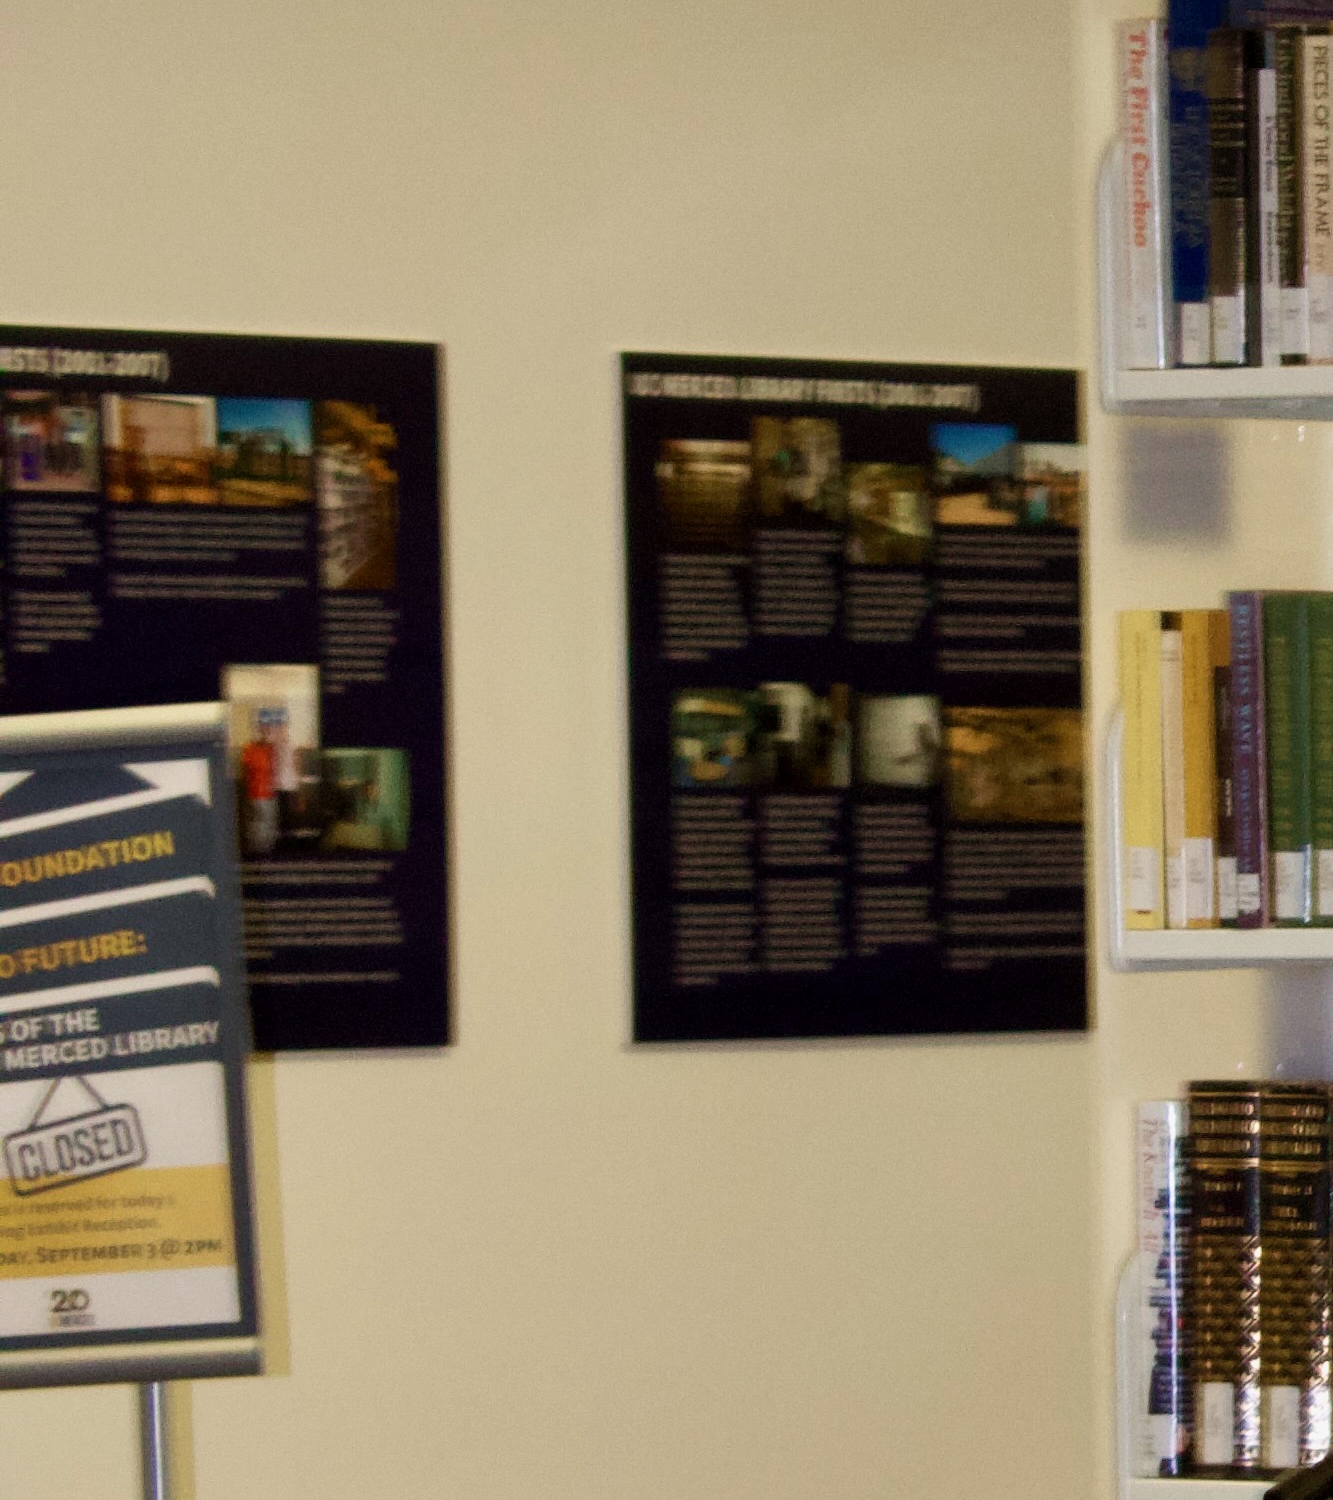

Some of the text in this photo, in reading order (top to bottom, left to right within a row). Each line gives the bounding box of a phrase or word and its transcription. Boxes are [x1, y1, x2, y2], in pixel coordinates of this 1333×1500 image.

[1129, 32, 1152, 248] The First Cuckoo
[1311, 44, 1333, 238] PIECES OF THE FRAME
[20, 930, 148, 975] FUTURE:
[3, 1020, 221, 1072] MERCED LIBRARY
[10, 1007, 101, 1046] OF THE
[17, 1117, 136, 1182] CLOSED
[36, 1237, 223, 1265] SEPTEMBER 3 @ 2PM
